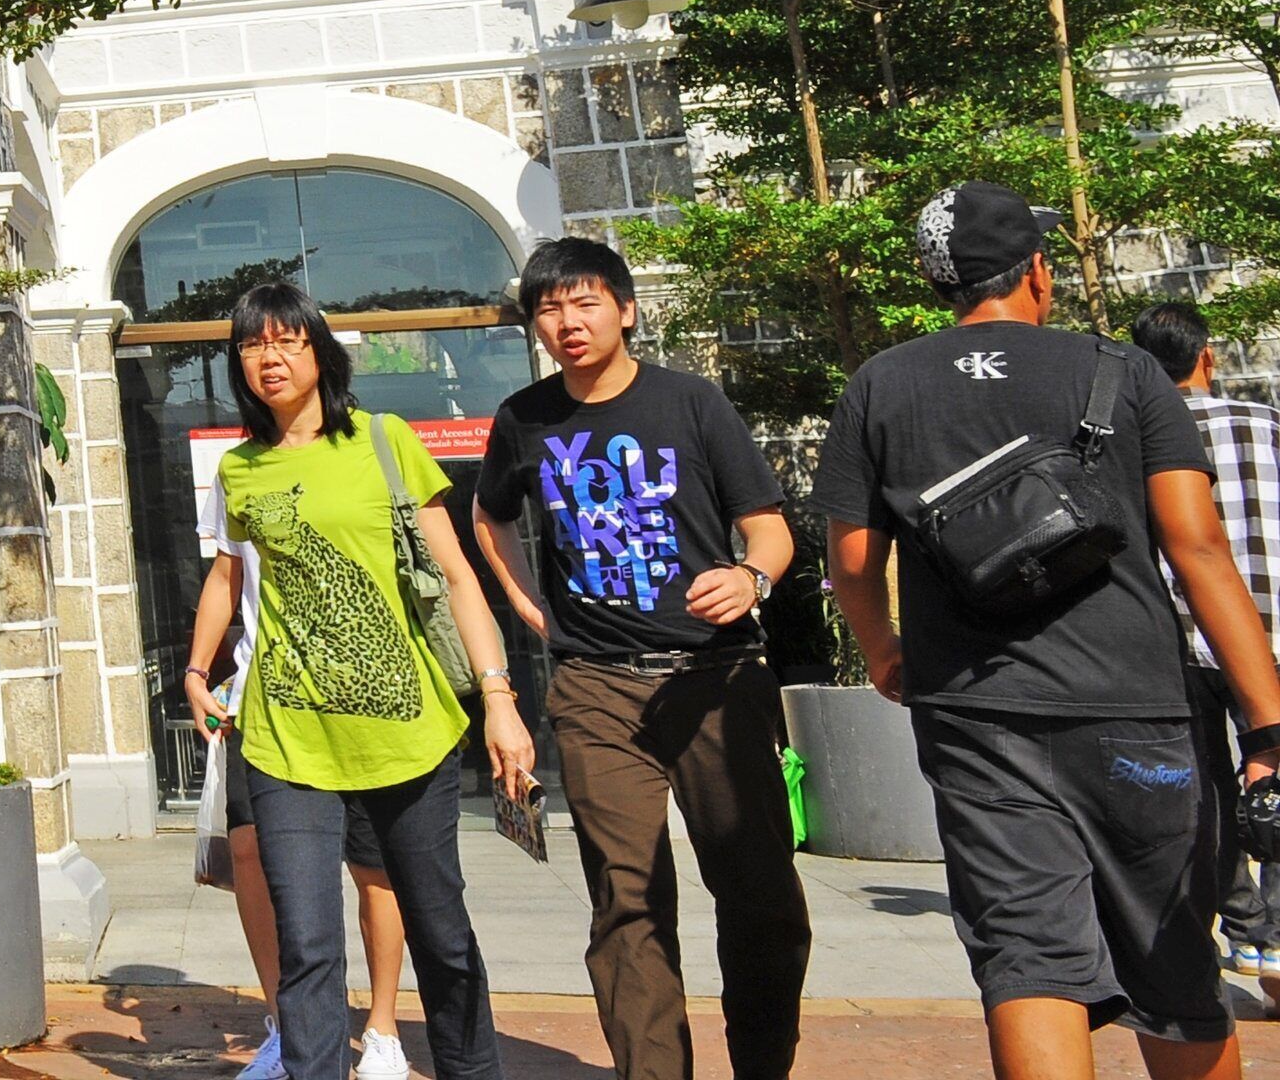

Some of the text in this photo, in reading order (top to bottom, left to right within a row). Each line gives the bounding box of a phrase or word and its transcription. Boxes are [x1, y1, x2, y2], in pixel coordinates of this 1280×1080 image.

[415, 427, 490, 438] dent Access On
